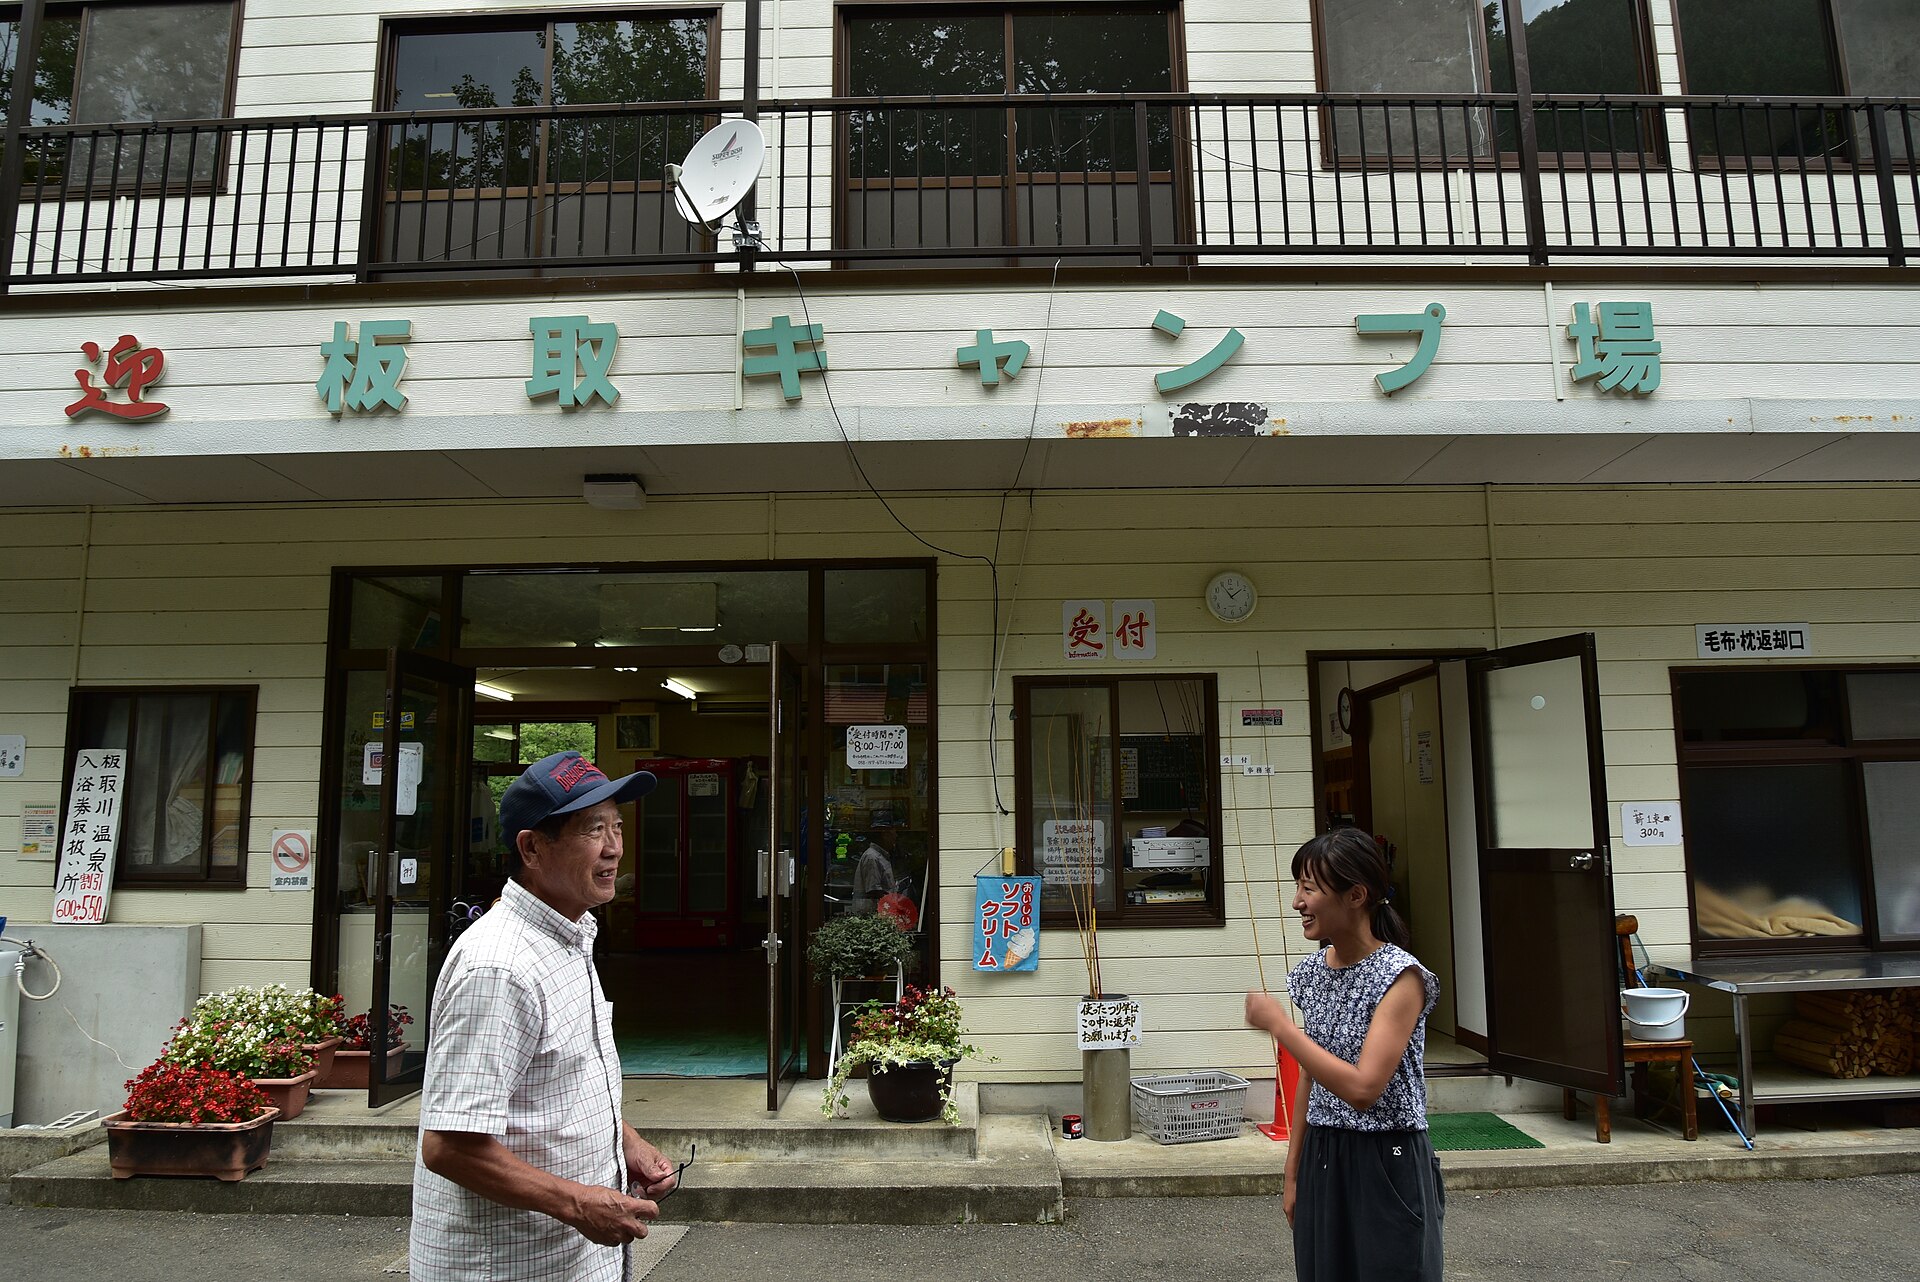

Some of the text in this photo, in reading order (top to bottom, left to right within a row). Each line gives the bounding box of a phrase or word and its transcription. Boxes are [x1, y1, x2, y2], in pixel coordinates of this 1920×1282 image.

[65, 301, 1661, 418] 迎 板取キャンプ場
[1068, 604, 1150, 649] 受付
[1704, 629, 1805, 652] 毛布・枕返却口
[852, 729, 887, 740] 受付時間
[57, 754, 99, 895] 入浴券取扱い所
[87, 754, 121, 873] 板取川温泉
[1640, 828, 1664, 838] 300円
[80, 873, 103, 891] 割引
[1021, 882, 1033, 926] おいしい
[1001, 883, 1020, 938] ソフト
[979, 901, 1000, 967] クリーム
[1081, 1016, 1136, 1028] この中に返却
[1081, 1028, 1131, 1043] お願いします
